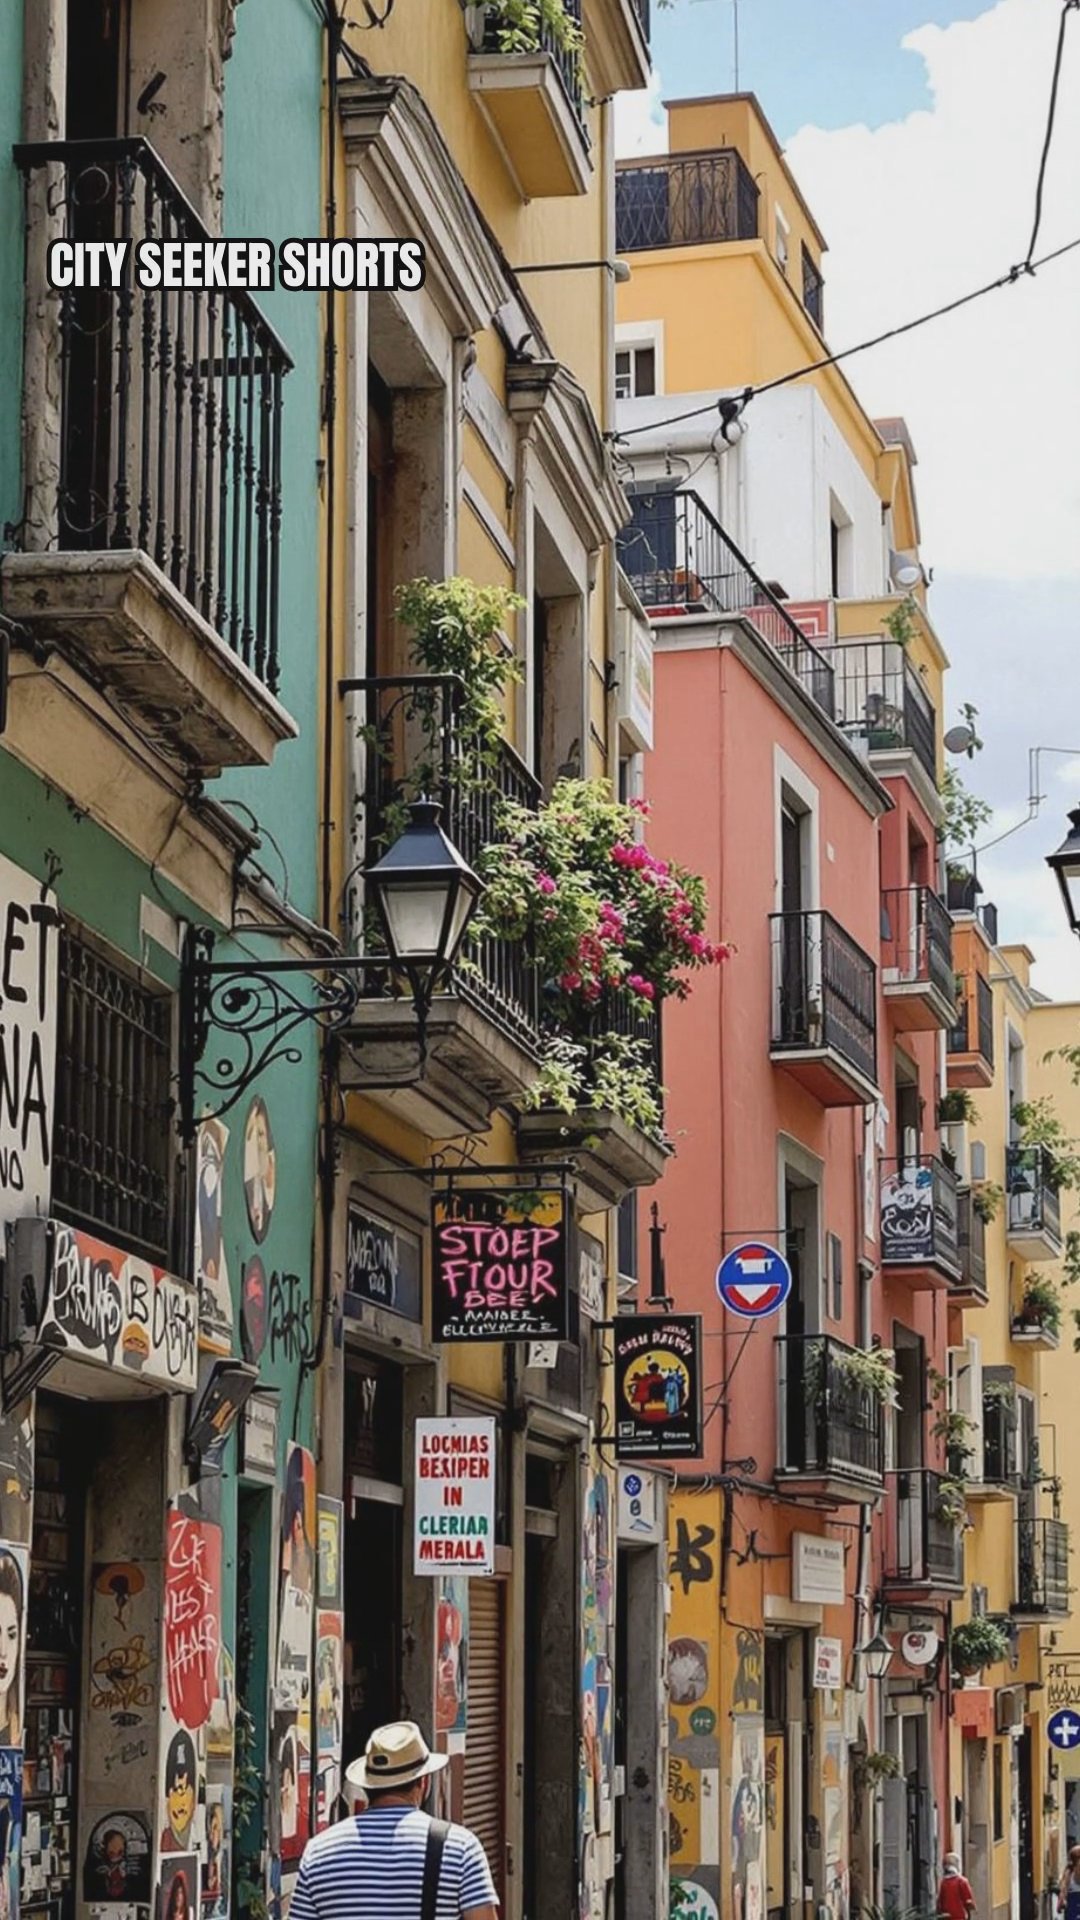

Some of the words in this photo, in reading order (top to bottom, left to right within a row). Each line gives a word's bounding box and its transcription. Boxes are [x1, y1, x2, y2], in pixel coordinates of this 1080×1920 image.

[440, 1226, 560, 1259] STOEP
[422, 1435, 489, 1454] LOCMIAS
[443, 1486, 463, 1506] IN
